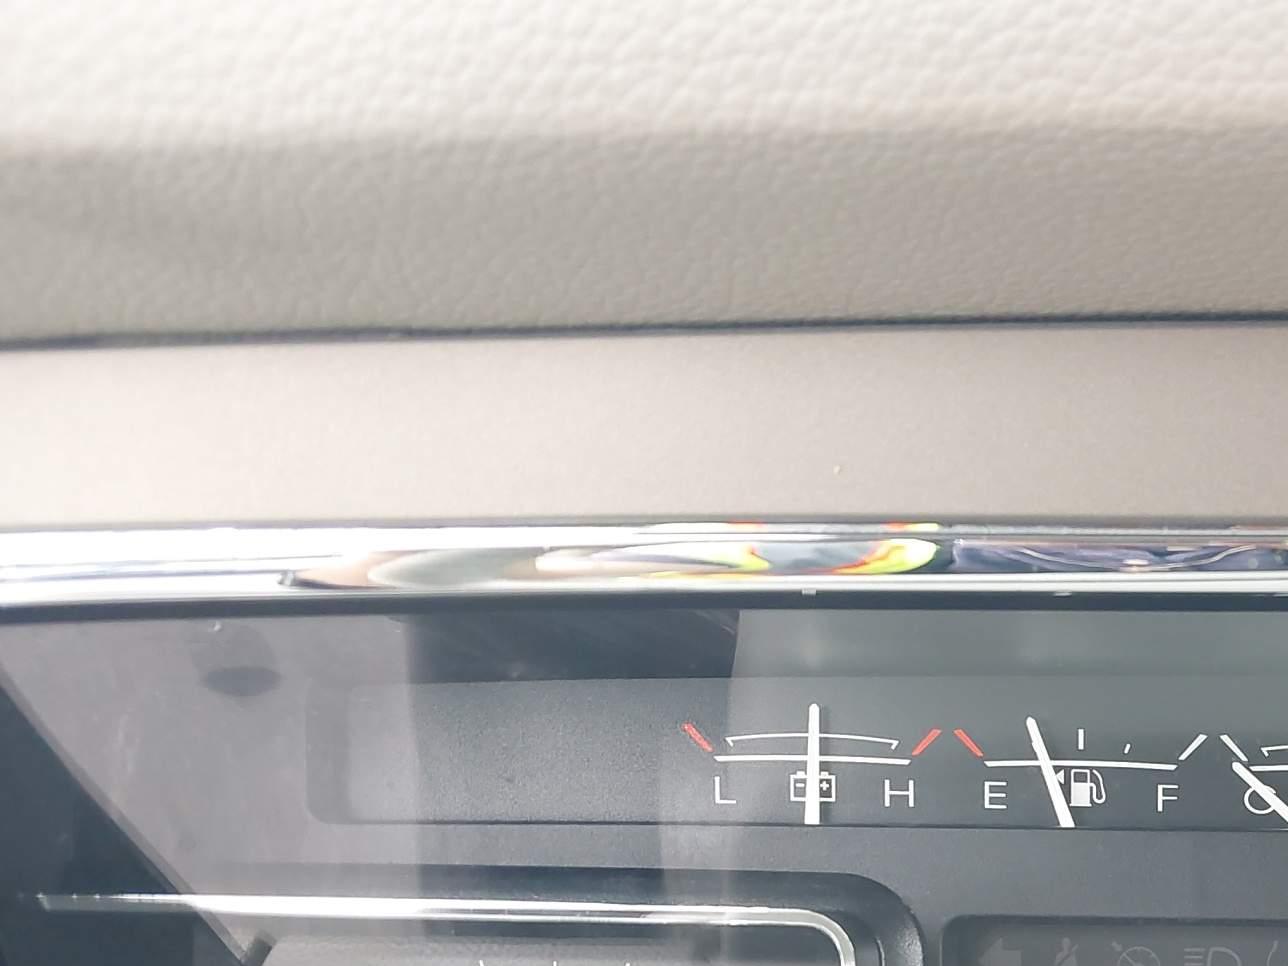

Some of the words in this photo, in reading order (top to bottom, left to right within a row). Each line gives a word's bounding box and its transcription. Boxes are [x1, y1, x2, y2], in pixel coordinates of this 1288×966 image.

[714, 776, 737, 805] L
[884, 779, 915, 808] H
[984, 781, 1007, 809] E
[1157, 784, 1179, 812] F
